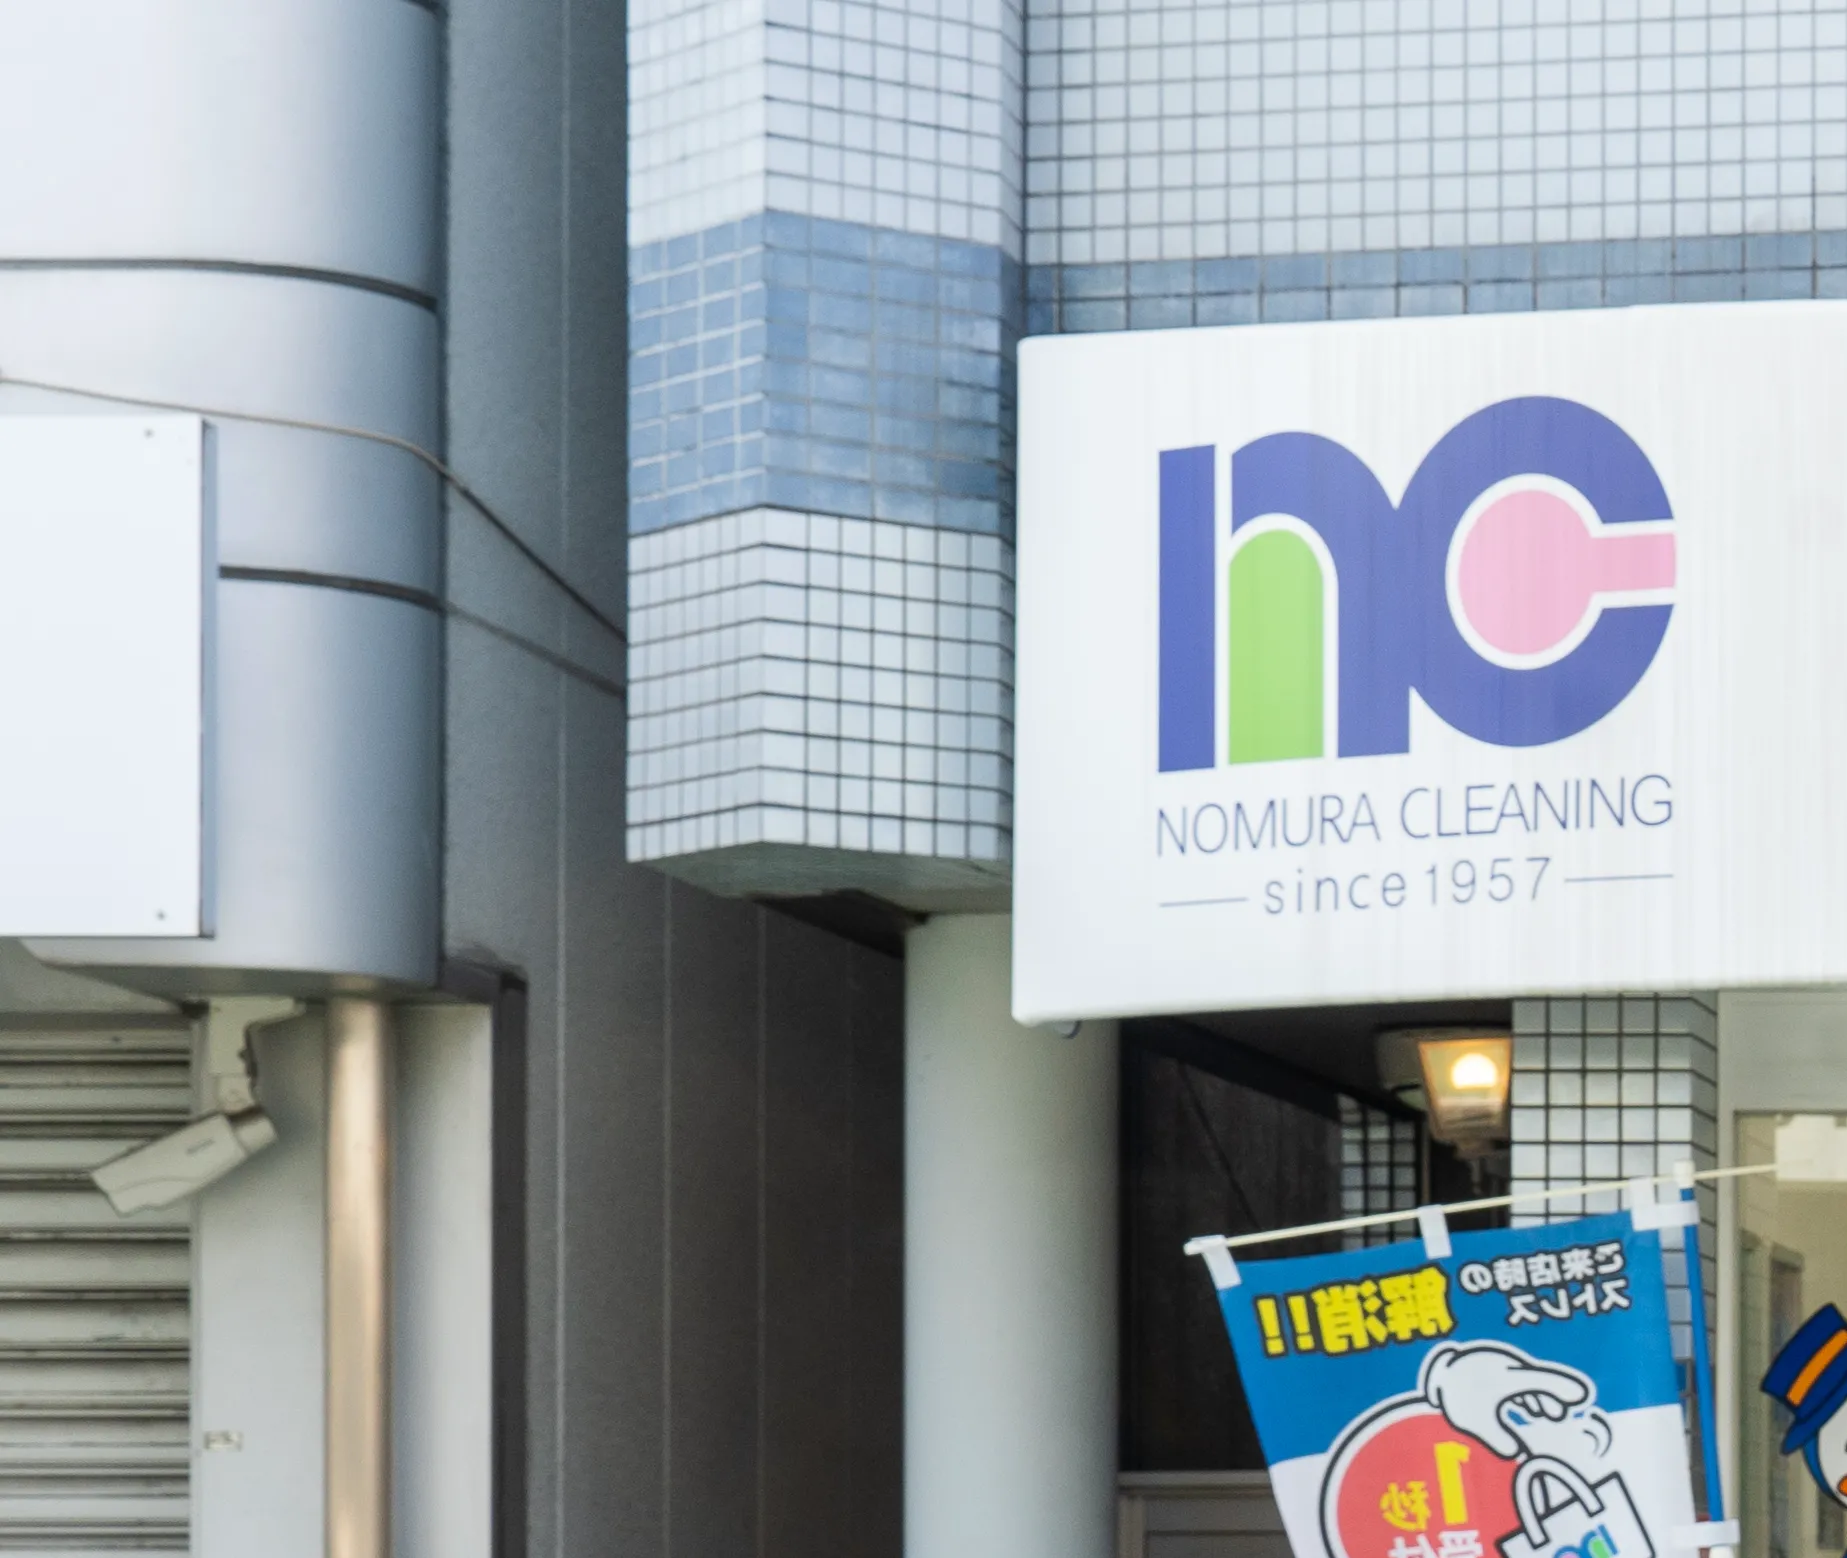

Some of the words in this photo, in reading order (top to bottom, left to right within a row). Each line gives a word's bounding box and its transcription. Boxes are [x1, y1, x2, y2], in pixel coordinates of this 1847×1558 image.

[1158, 395, 1677, 773] nc
[1157, 794, 1380, 857] NOMURA
[1399, 775, 1674, 840] CLEANING
[1264, 868, 1407, 915] since
[1427, 857, 1552, 905] 1957
